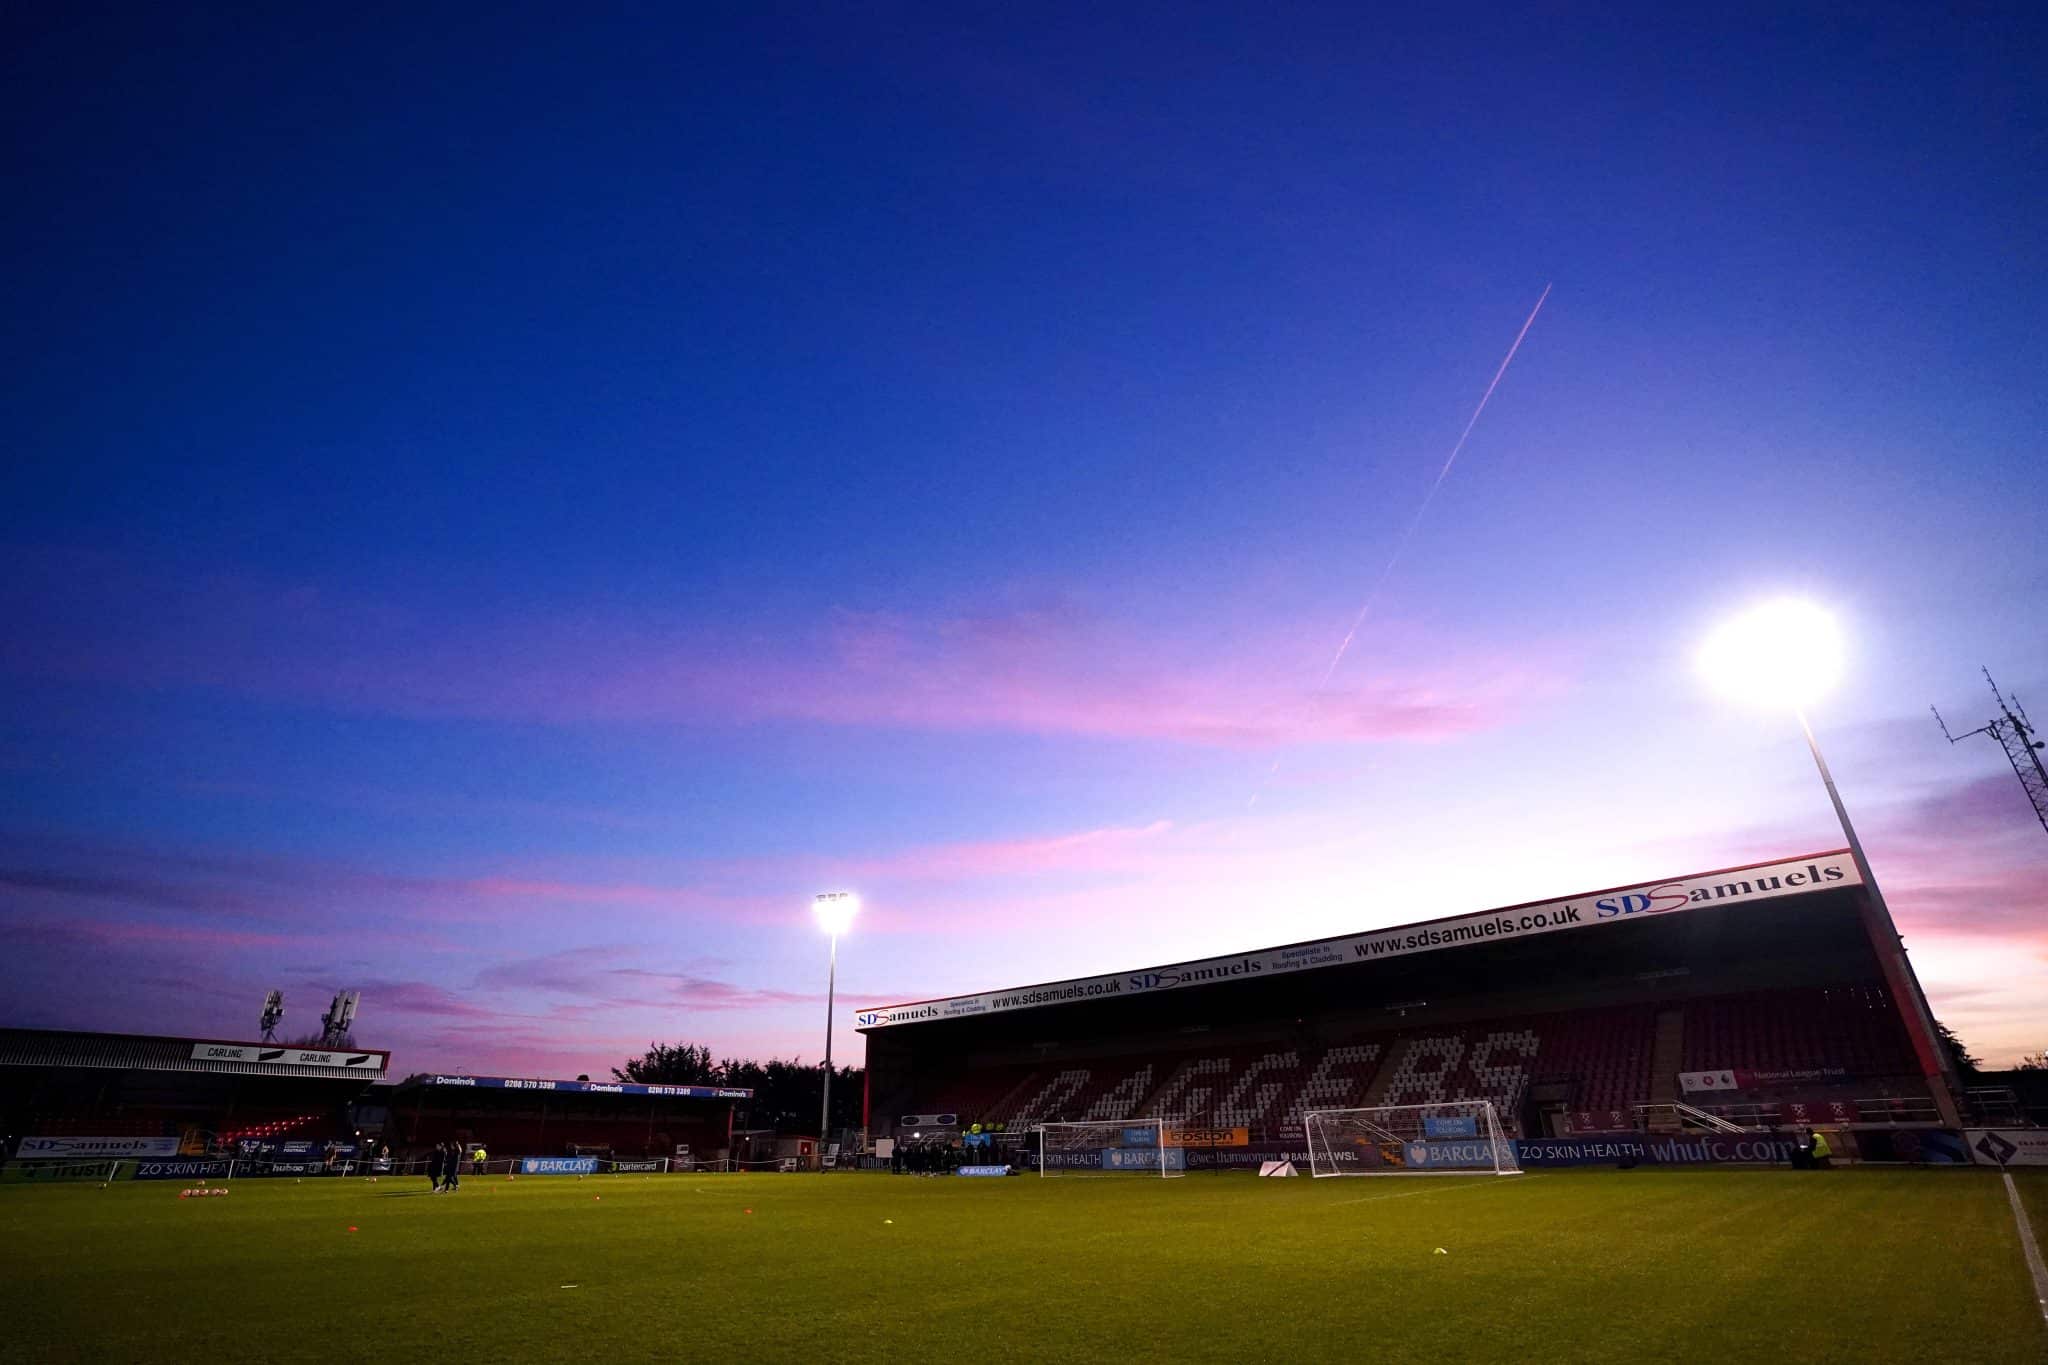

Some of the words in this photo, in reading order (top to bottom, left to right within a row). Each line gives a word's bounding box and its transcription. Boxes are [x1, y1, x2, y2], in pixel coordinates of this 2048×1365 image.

[1354, 904, 1581, 957] www.sdsamuels.co.uk
[992, 978, 1121, 1009] www.sdsamuels.co.uk
[207, 1047, 242, 1058] CARLING
[300, 1053, 331, 1063] CARLING
[436, 1076, 476, 1086] Domino's
[590, 1083, 624, 1093] Domino's
[718, 1090, 747, 1098] Domino's
[1431, 1144, 1512, 1161] BARCLAS
[1547, 1144, 1582, 1159] SKIN
[1584, 1143, 1645, 1158] HEALTH
[1650, 1137, 1796, 1162] whufc.com
[1067, 1153, 1100, 1165] HEALTH
[1333, 1151, 1358, 1161] WSL
[138, 1163, 161, 1176] ZO
[165, 1162, 198, 1175] SKIN
[540, 1159, 595, 1172] BARCLAYS
